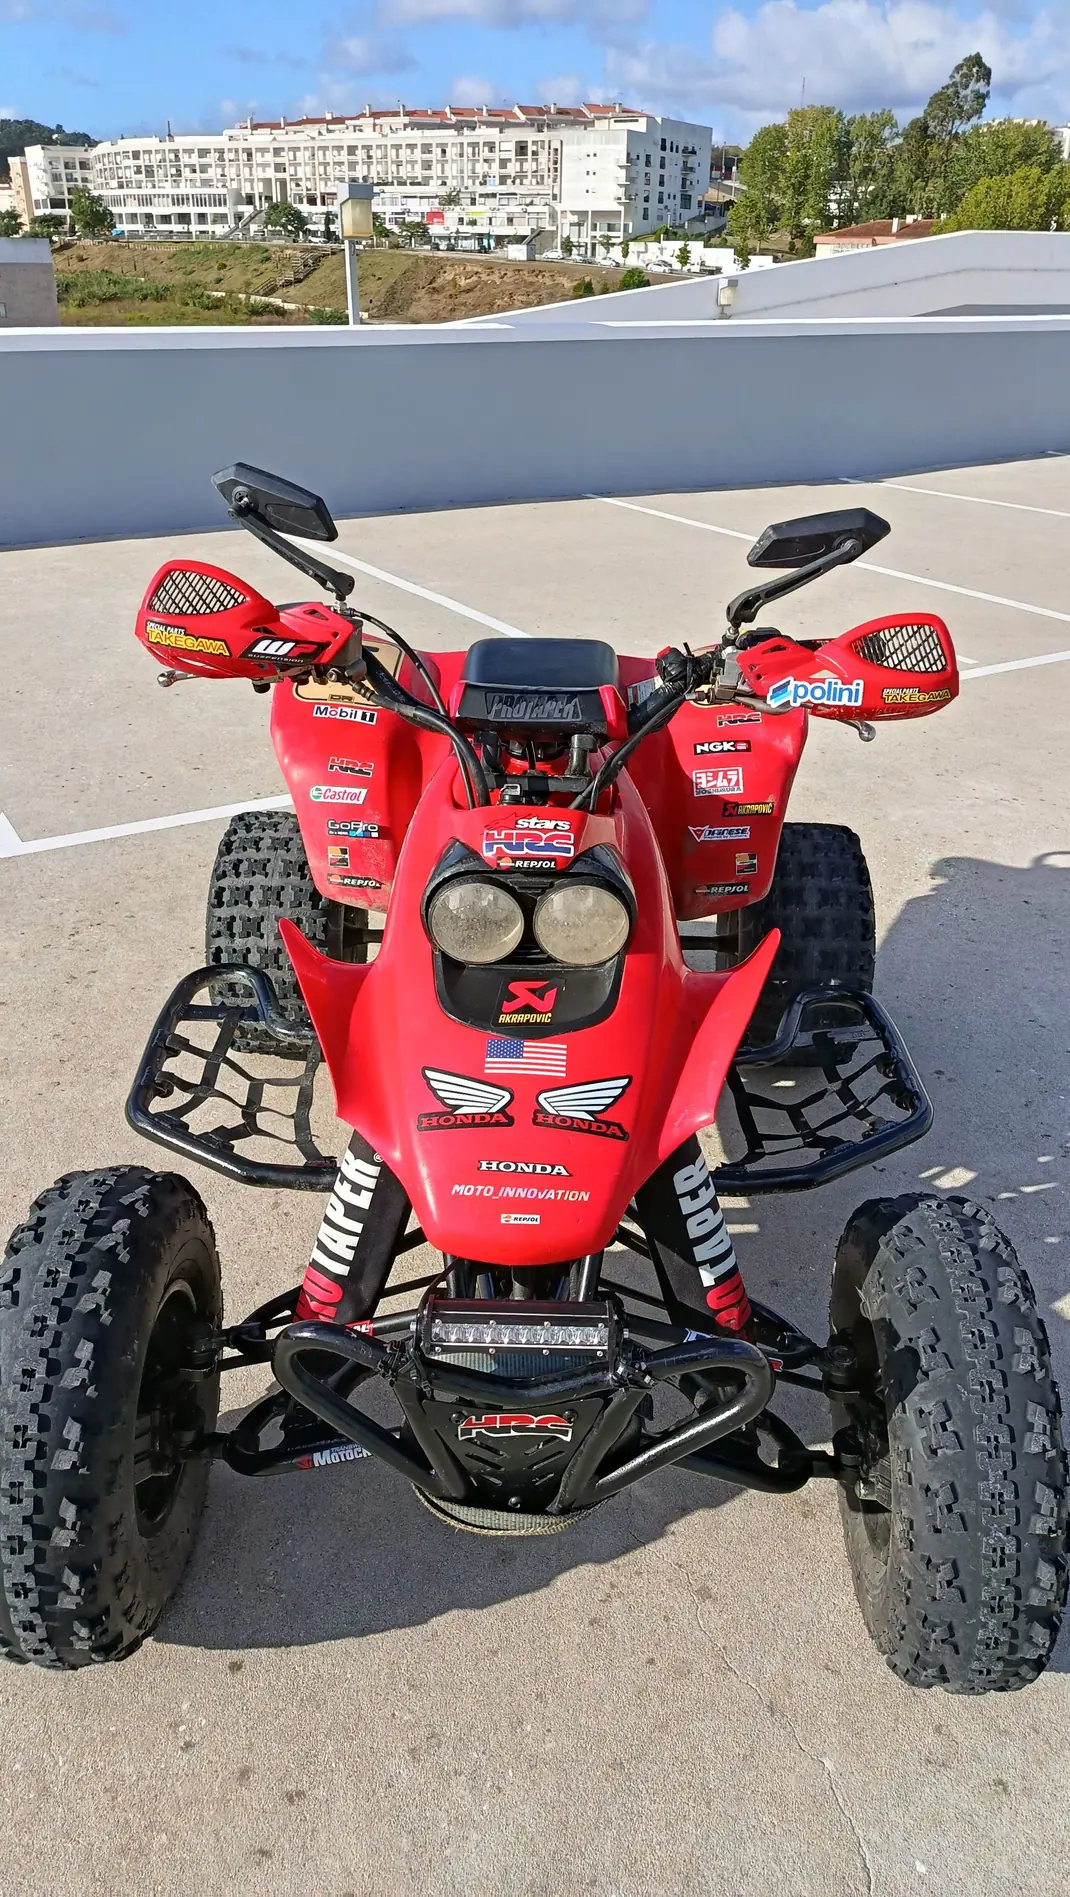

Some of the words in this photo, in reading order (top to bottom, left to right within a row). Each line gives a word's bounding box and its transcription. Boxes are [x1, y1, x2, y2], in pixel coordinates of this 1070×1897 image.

[147, 628, 230, 656] TAKEGAWA
[252, 639, 318, 657] WP
[793, 681, 860, 703] polini
[883, 690, 951, 703] TAKEGAWA
[315, 706, 357, 720] Mobil
[717, 712, 762, 728] HRC
[696, 741, 736, 754] NGK
[328, 756, 374, 778] HRC
[696, 771, 738, 788] ヨシムラ
[323, 788, 362, 801] Castrol
[328, 820, 379, 832] GoPro
[515, 816, 571, 830] stars
[482, 829, 574, 858] HRC
[515, 860, 556, 869] REPSOL
[710, 884, 749, 894] REPSOL
[420, 1112, 509, 1128] HONDA
[535, 1113, 625, 1138] HONDA
[479, 1160, 570, 1176] HONDA
[451, 1184, 590, 1202] MOTO_INNOVATION
[458, 1413, 574, 1442] HRC
